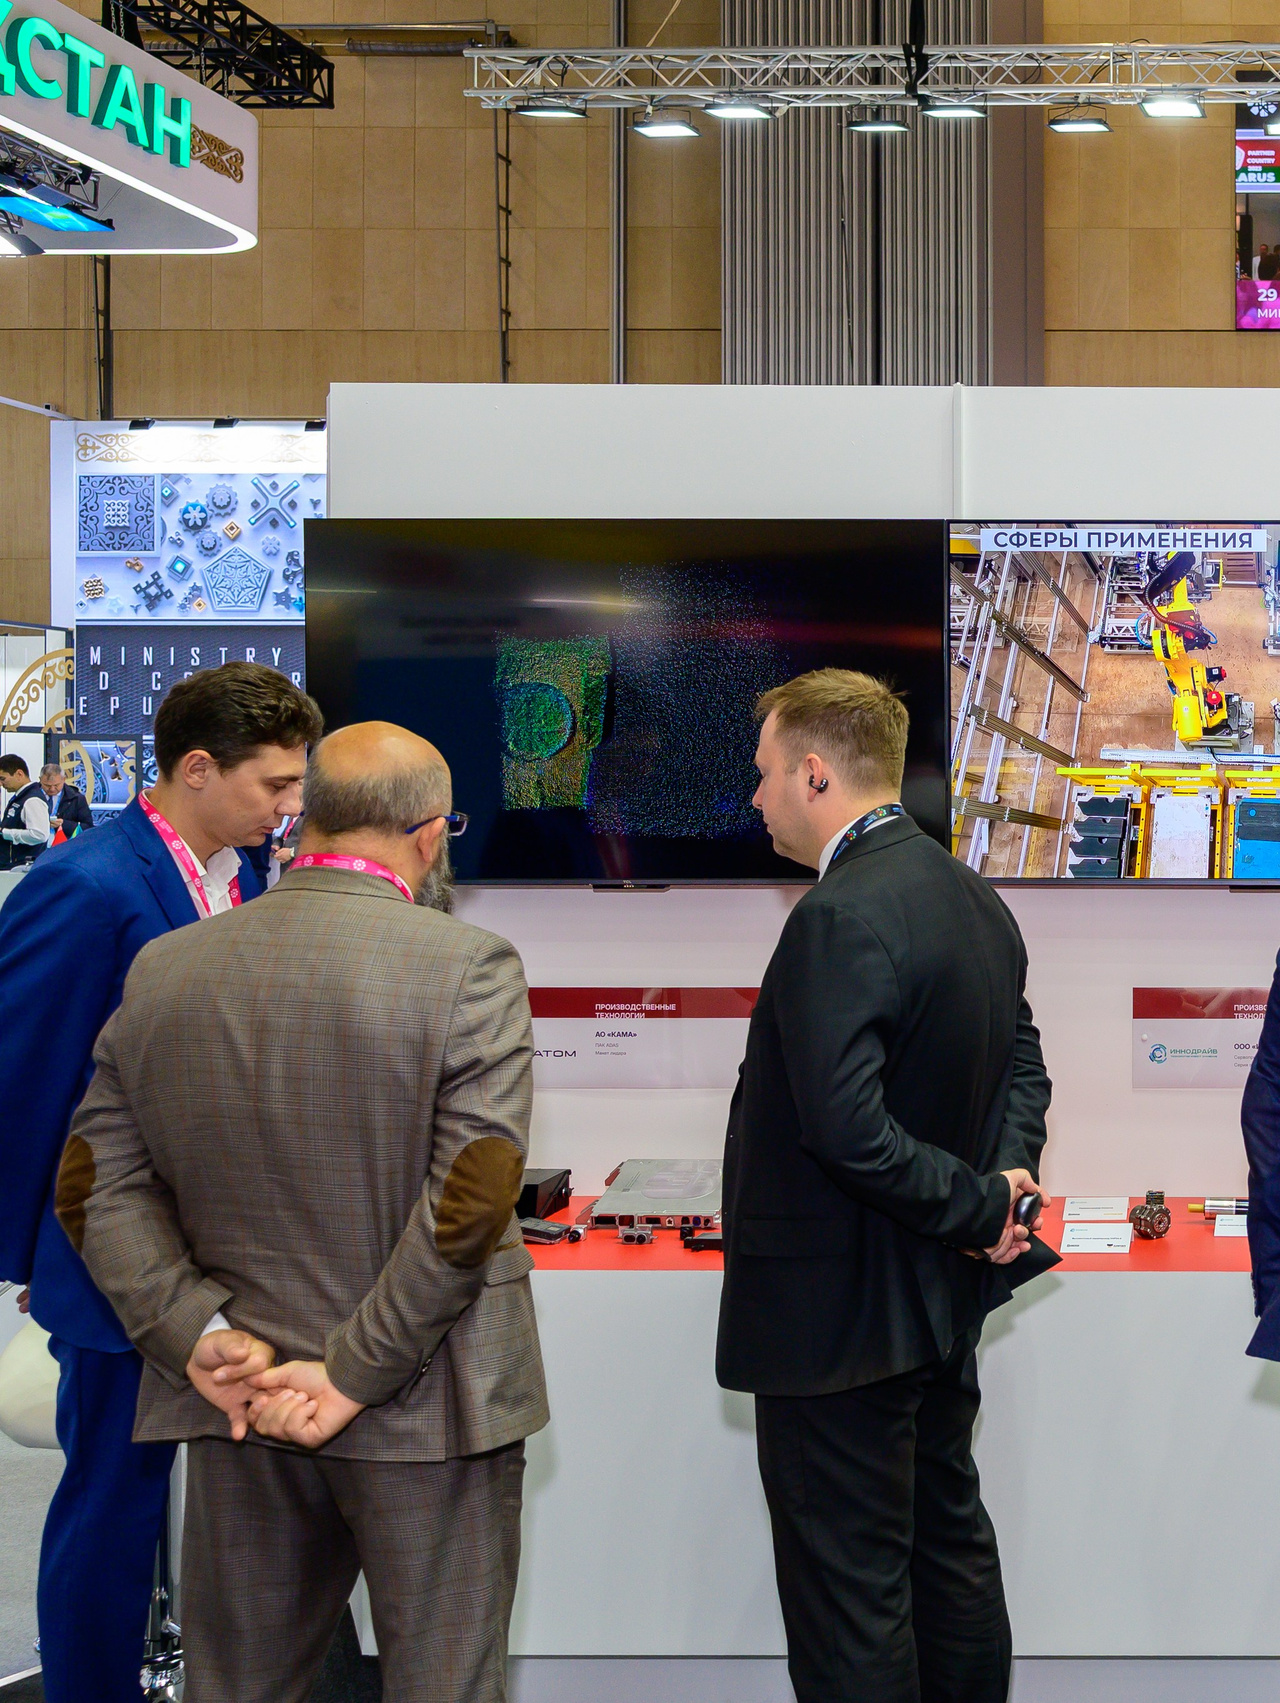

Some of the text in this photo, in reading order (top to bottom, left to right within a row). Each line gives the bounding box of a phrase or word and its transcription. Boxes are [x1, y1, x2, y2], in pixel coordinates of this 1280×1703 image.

[0, 0, 192, 168] СТАН
[1257, 290, 1278, 302] 29
[993, 531, 1252, 549] СФЕРЫ ПРИМЕНЕНИЯ
[89, 646, 282, 667] MINISTRY
[595, 1003, 677, 1012] ПРОИЗВОДСТВЕННЫЕ
[1169, 1047, 1218, 1055] ИННОДРАЙВ
